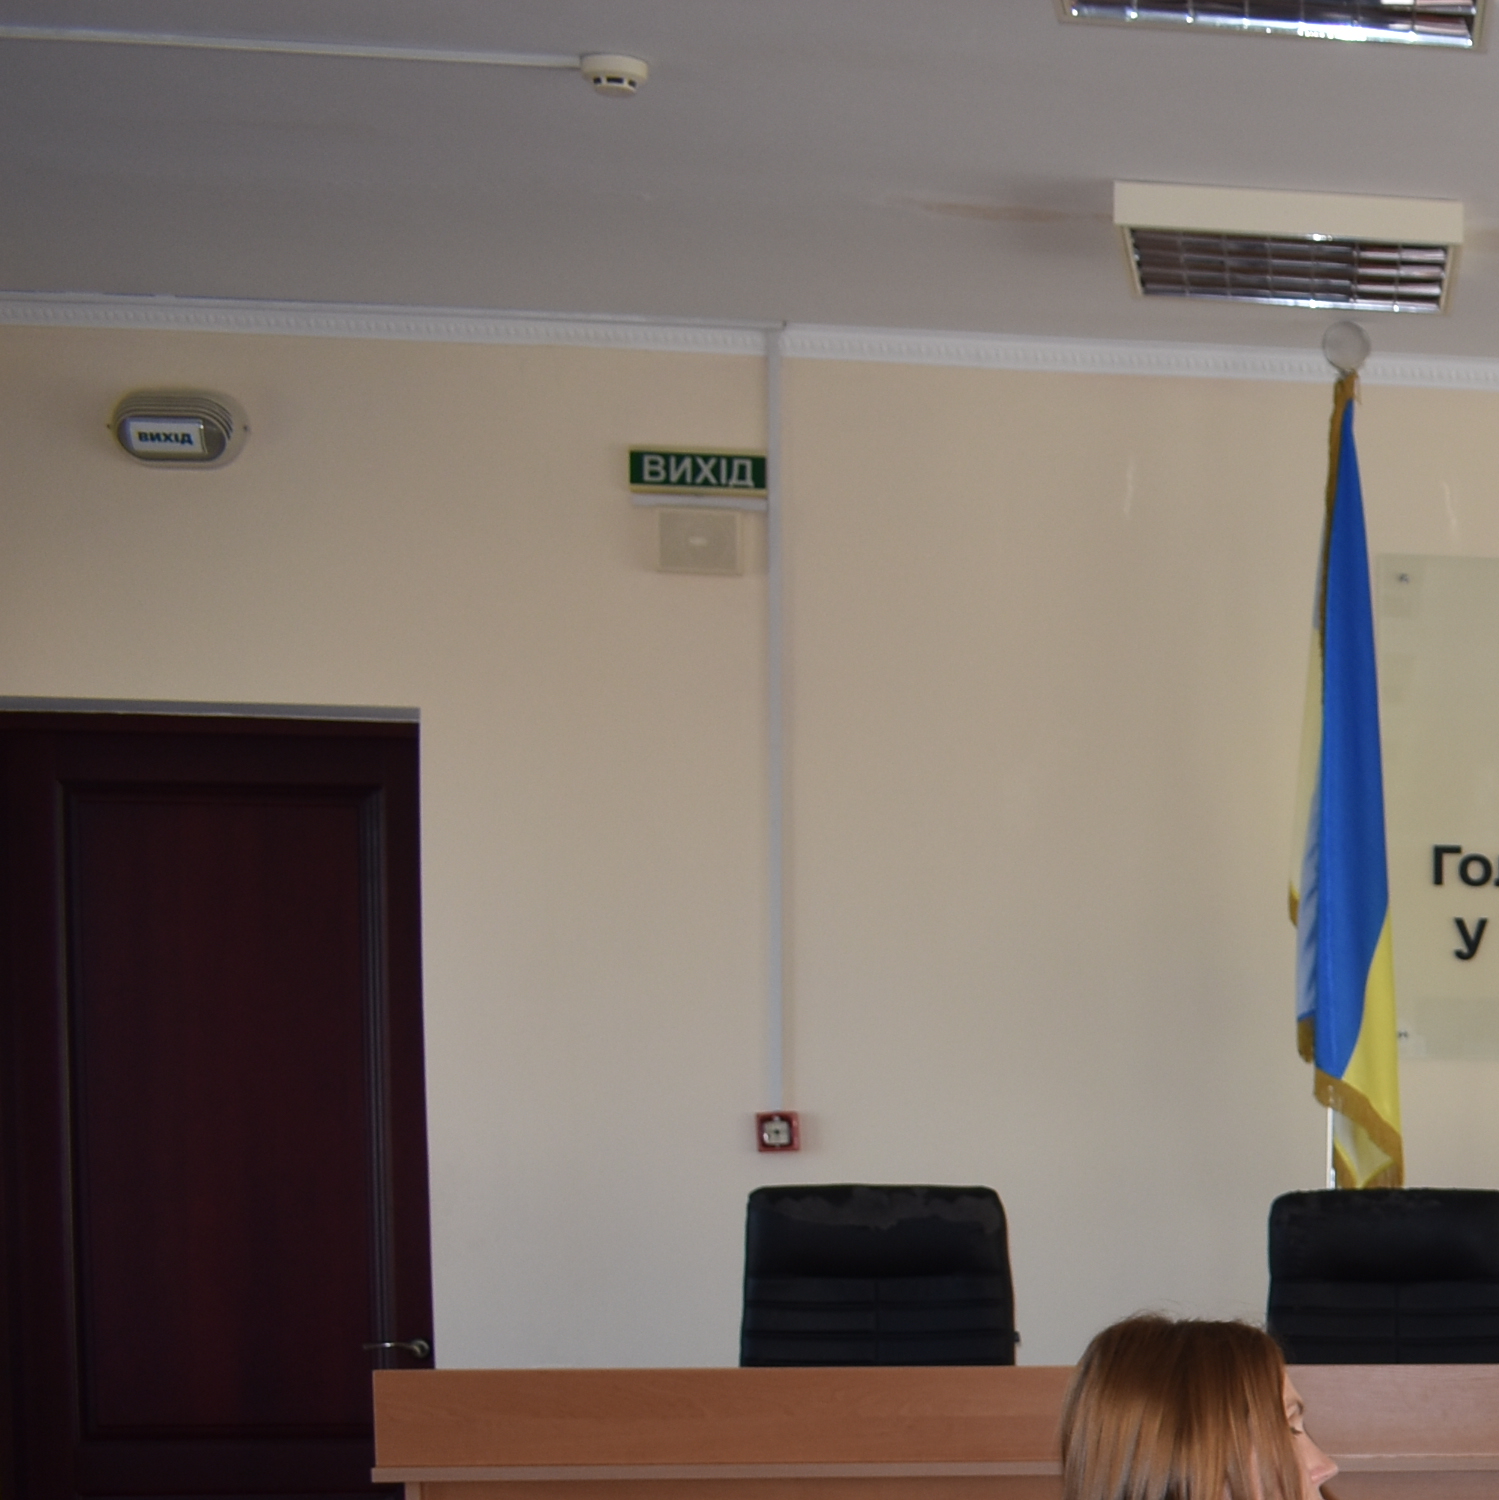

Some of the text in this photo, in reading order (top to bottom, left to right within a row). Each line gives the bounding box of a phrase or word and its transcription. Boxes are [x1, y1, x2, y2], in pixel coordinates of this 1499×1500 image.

[137, 431, 194, 446] ВИХІД
[641, 453, 755, 489] ВИХІД
[1452, 917, 1490, 963] у
